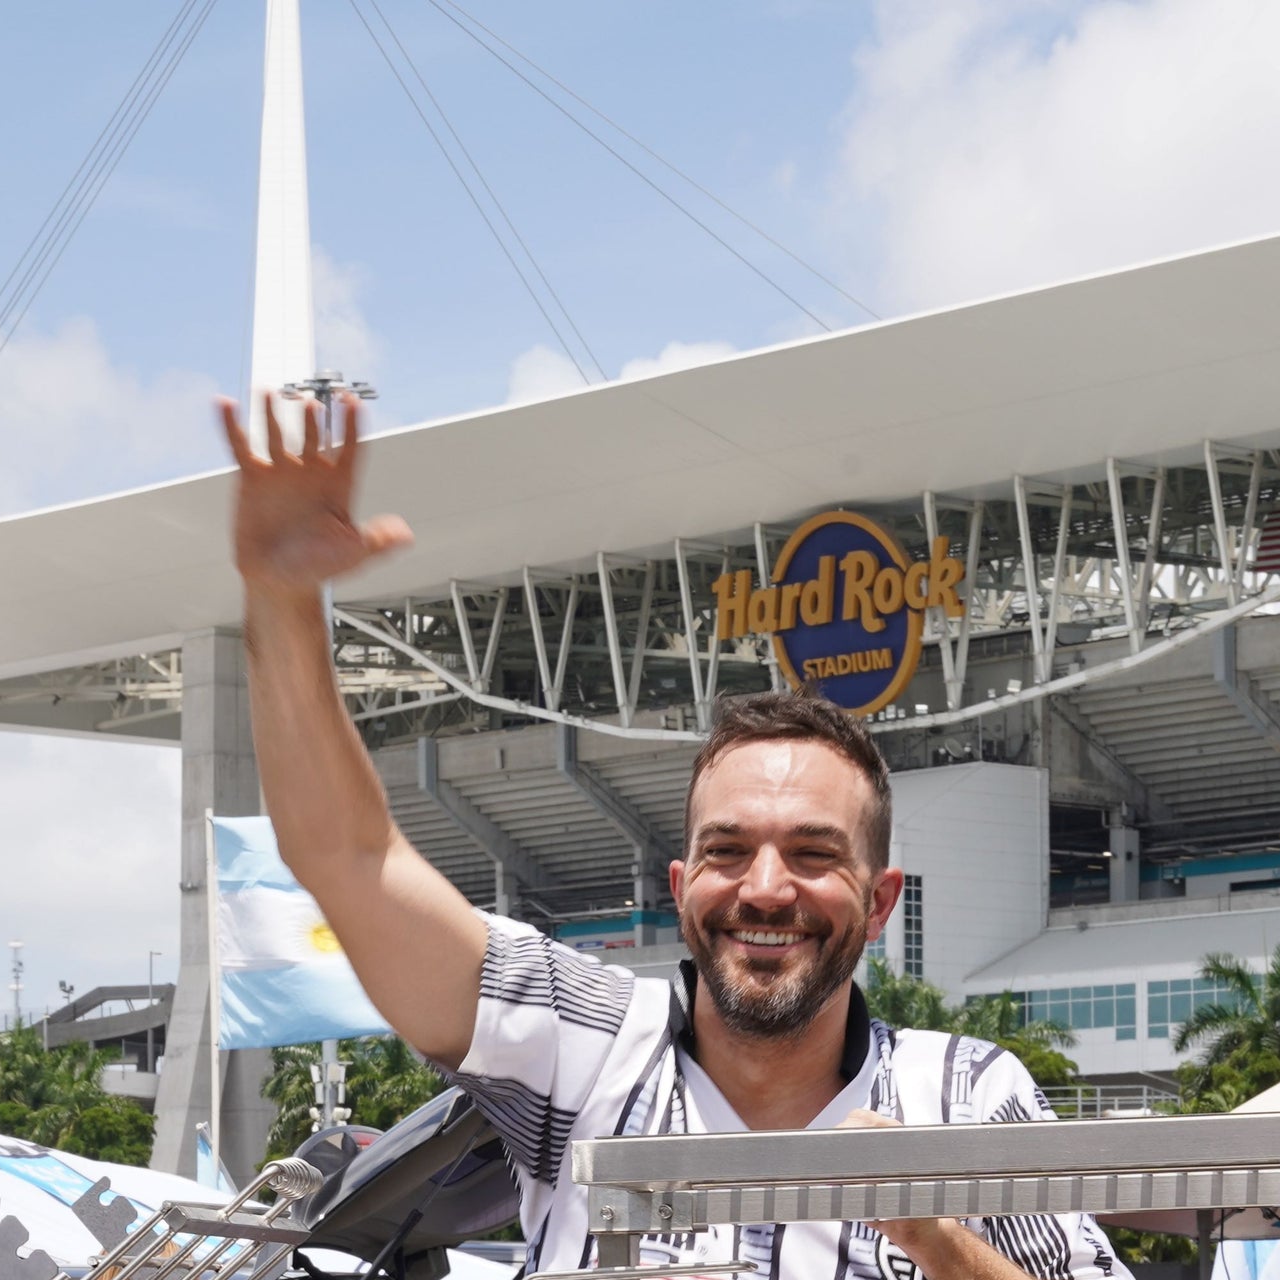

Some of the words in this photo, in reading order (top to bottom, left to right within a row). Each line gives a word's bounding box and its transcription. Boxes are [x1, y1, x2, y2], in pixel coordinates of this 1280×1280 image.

[712, 555, 835, 640] Hard
[840, 536, 965, 633] Rock
[803, 648, 893, 679] STADIUM
